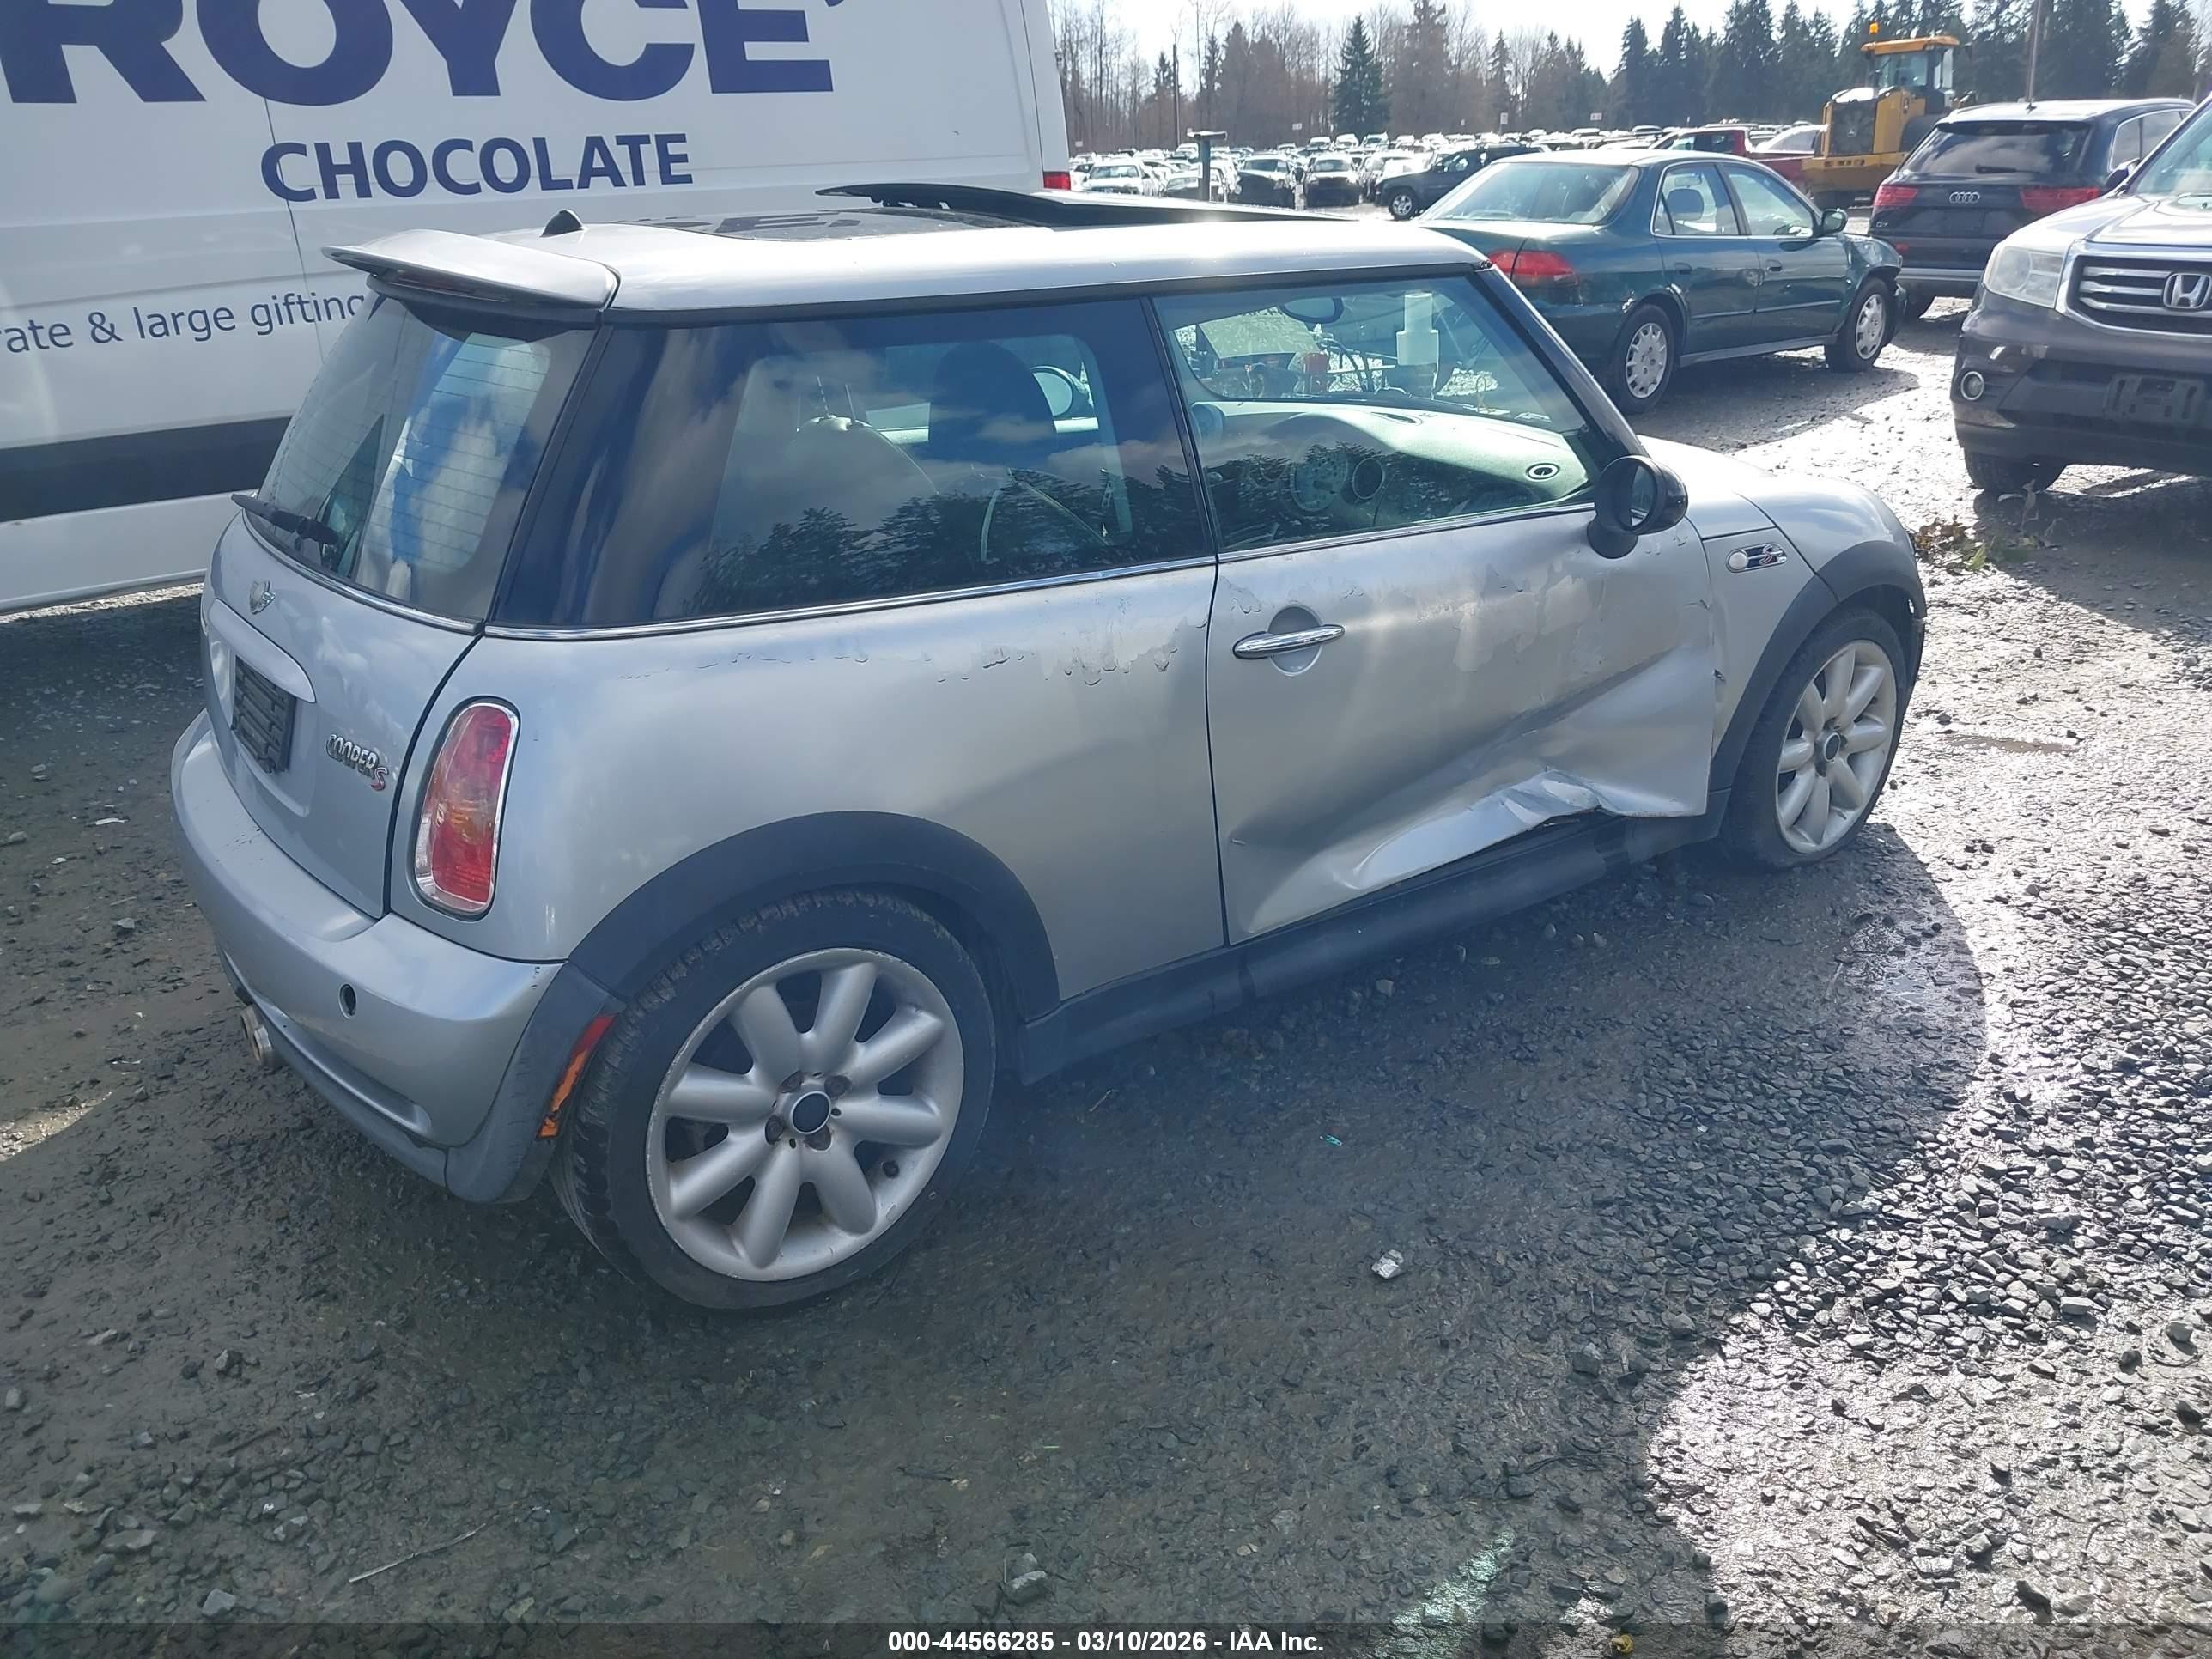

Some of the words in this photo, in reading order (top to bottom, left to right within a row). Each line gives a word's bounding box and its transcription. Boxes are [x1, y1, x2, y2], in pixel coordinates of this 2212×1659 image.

[0, 0, 844, 106] ROYCE
[261, 132, 693, 202] CHOCOLATE
[0, 319, 74, 353] ate
[88, 311, 124, 343] &
[132, 307, 236, 342] large
